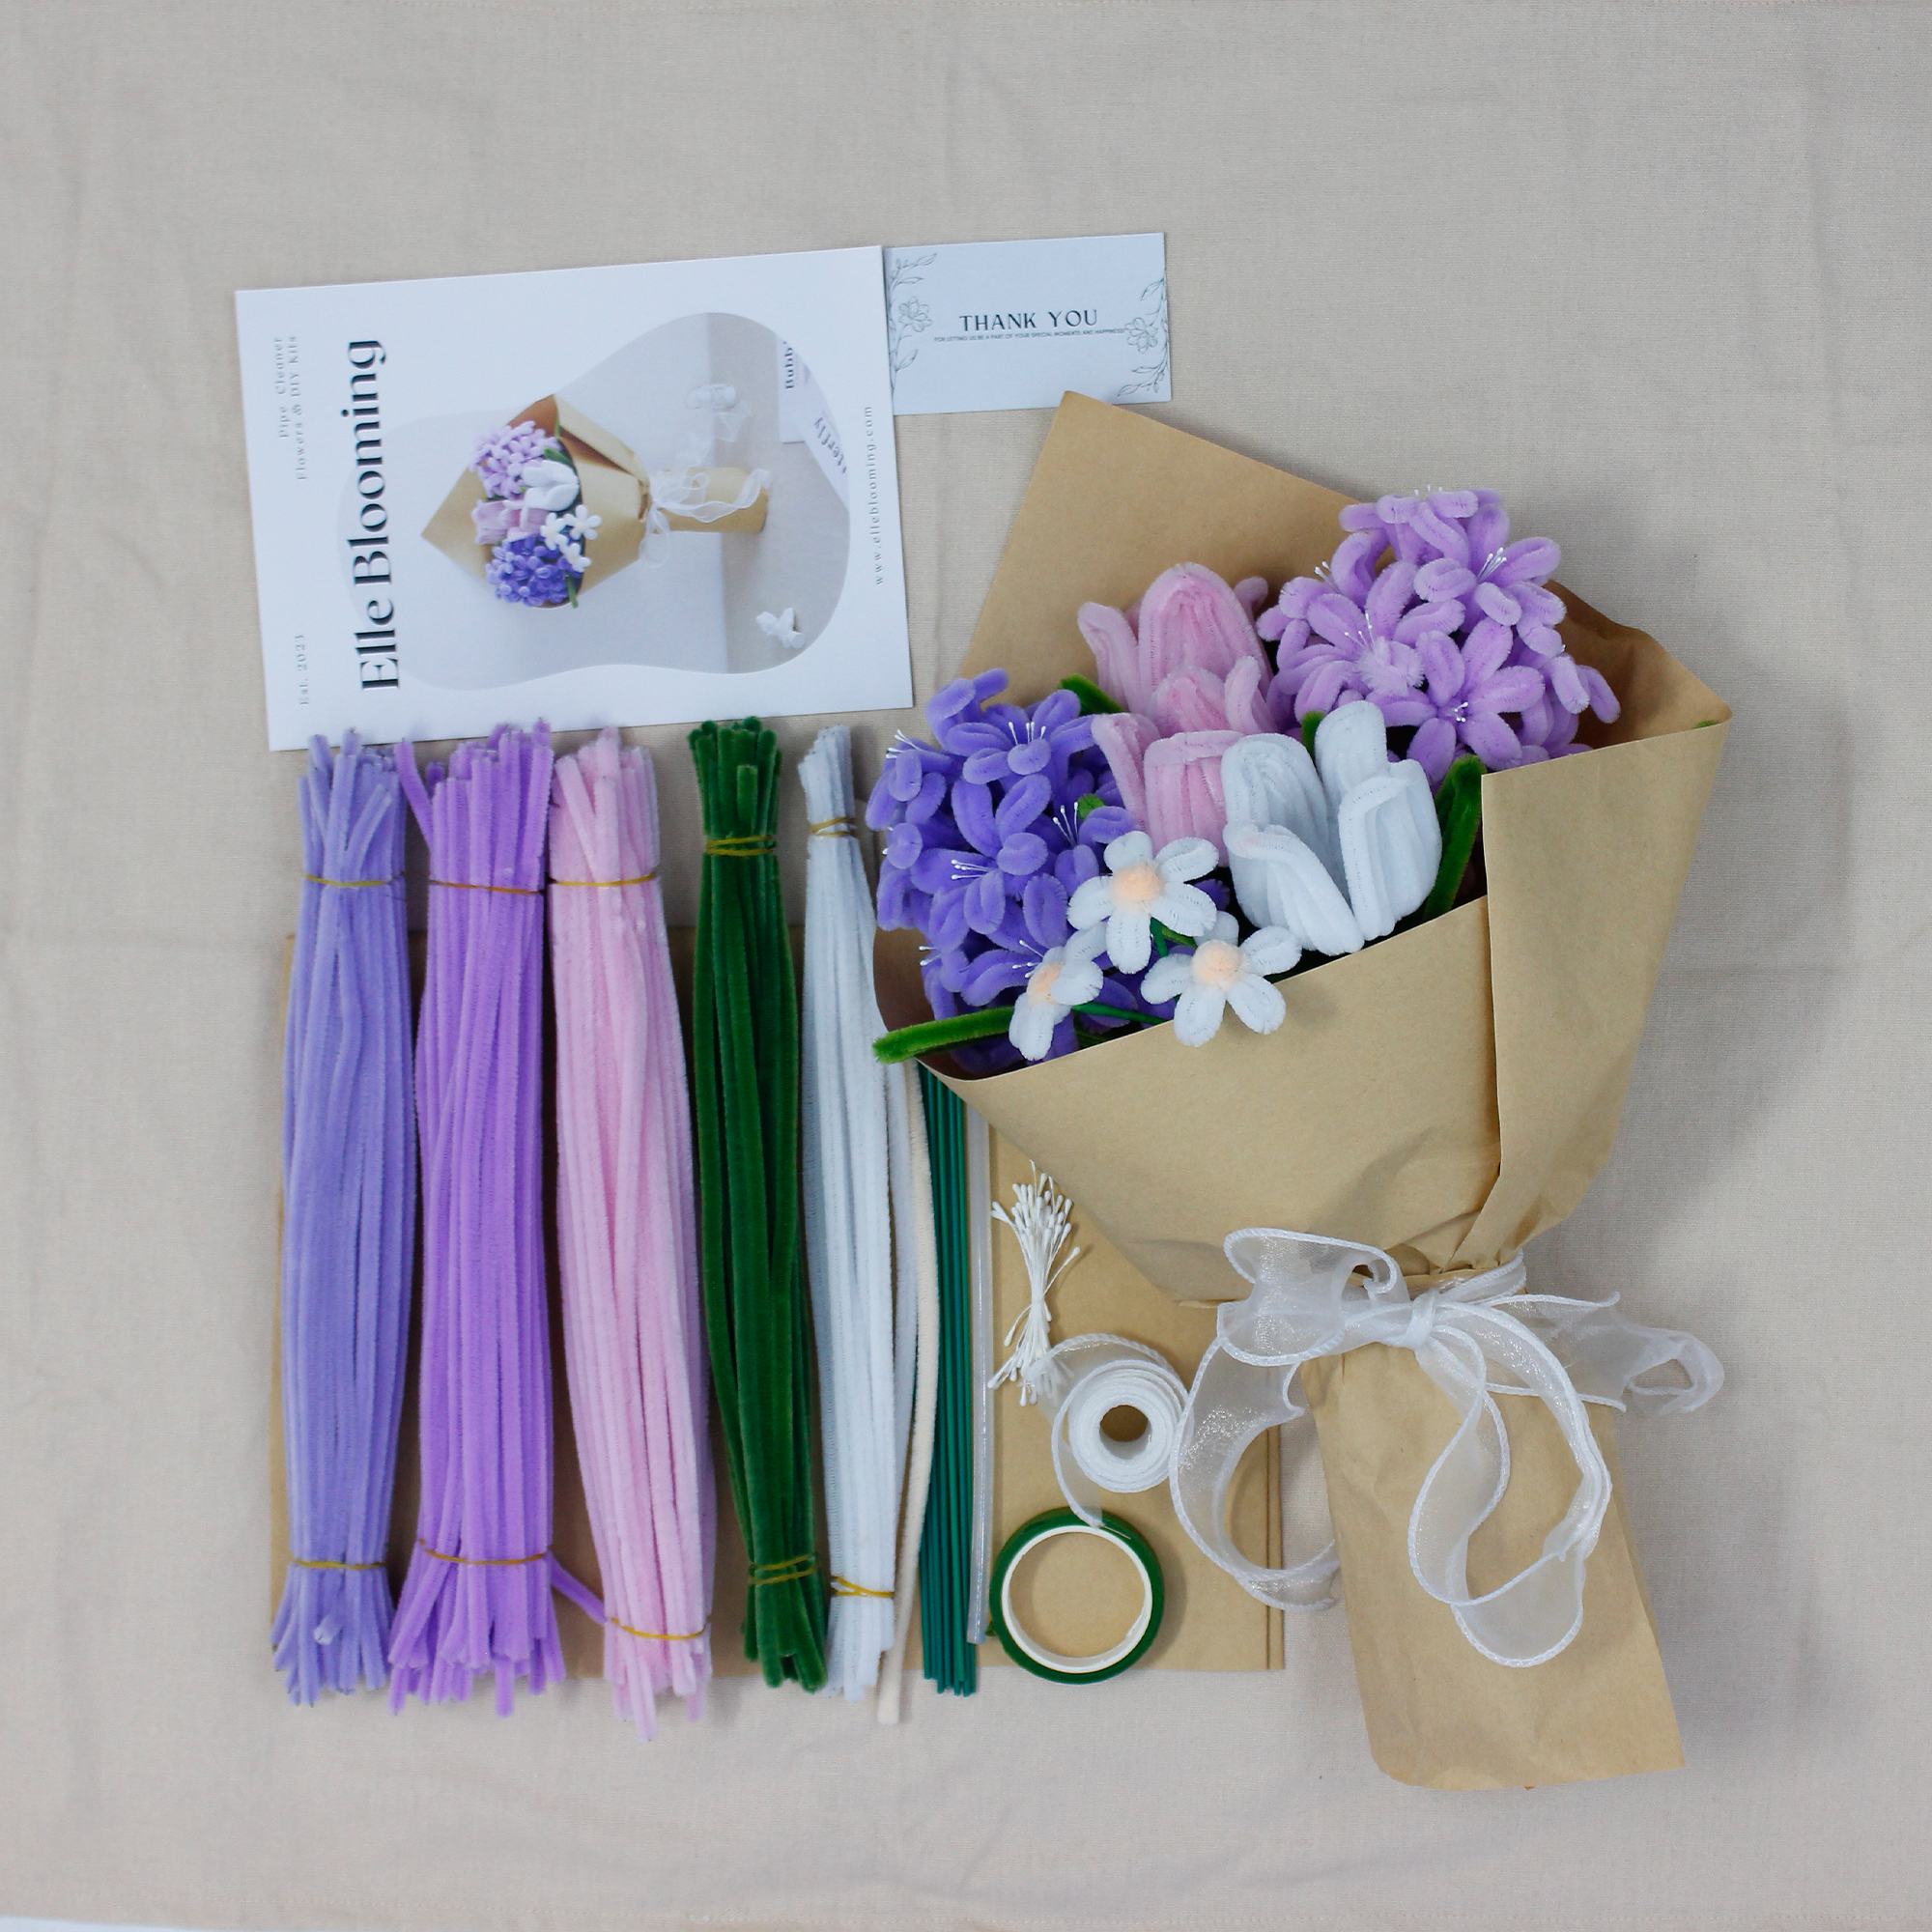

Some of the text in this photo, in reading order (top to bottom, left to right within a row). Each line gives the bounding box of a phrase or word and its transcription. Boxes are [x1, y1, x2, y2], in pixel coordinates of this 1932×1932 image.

[959, 309, 1097, 331] THANK YOU
[288, 336, 298, 364] Kits
[783, 341, 794, 389] Bubb
[274, 337, 291, 438] Pipe Cleaner
[290, 372, 300, 397] DIY
[296, 422, 307, 480] Flowers
[342, 341, 399, 690] Elle Blooming
[865, 406, 883, 585] www.elleblooming.com
[294, 633, 309, 705] Est. 2023
